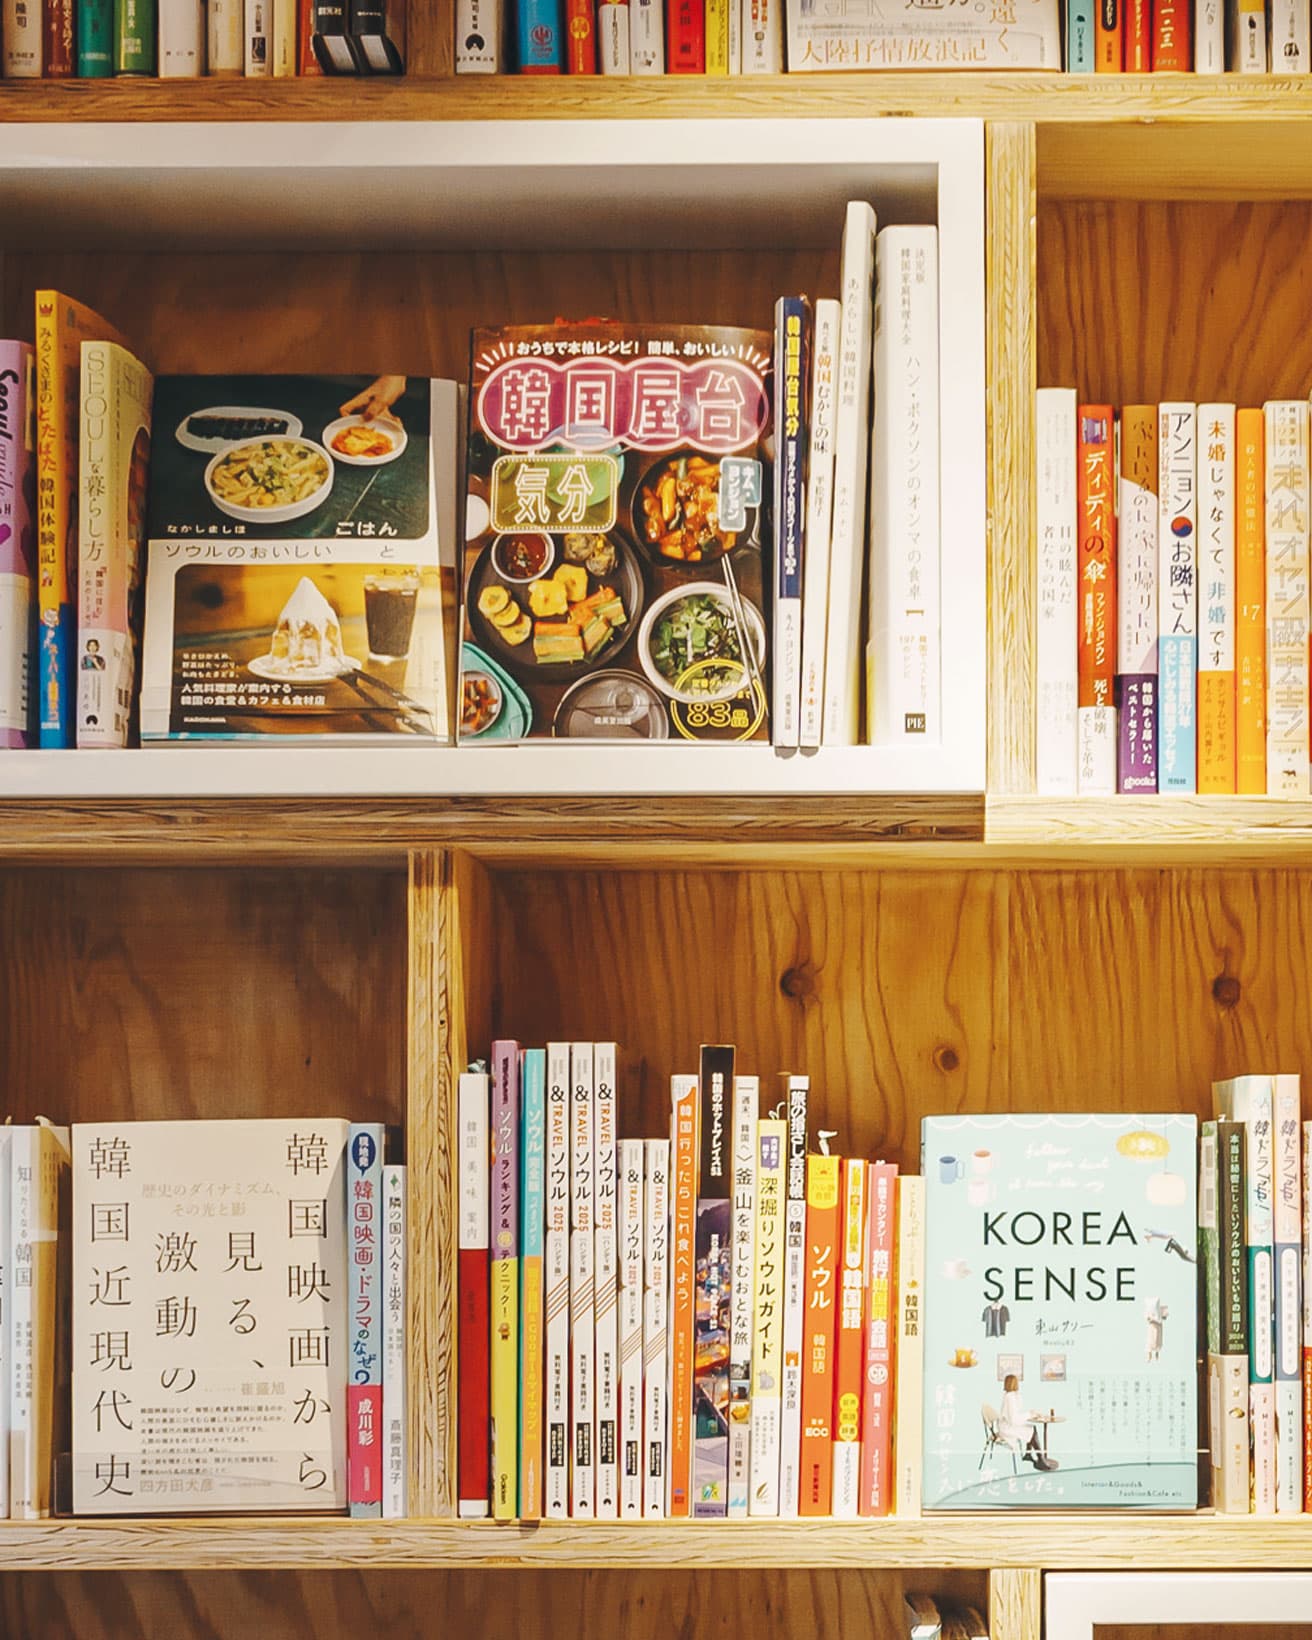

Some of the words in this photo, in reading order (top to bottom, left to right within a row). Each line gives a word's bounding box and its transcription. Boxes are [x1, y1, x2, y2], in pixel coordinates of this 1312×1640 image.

[500, 368, 745, 441] 韓国屋台
[1170, 412, 1193, 515] アンニョン
[514, 464, 595, 523] 気分
[1084, 450, 1106, 585] ディディの傘
[166, 544, 332, 560] ソウルのおいしい
[380, 544, 396, 559] と
[335, 520, 398, 537] ごはん
[1207, 420, 1227, 667] 未婚じゃなくて、非婚です
[1171, 539, 1193, 635] お隣さん
[499, 1110, 513, 1154] ソウル
[551, 1151, 567, 1201] ソウル
[575, 1151, 591, 1201] ソウル
[599, 1149, 615, 1199] ソウル
[553, 1205, 564, 1233] 2025
[578, 1205, 589, 1233] 2025
[602, 1203, 613, 1231] 2025
[627, 1223, 640, 1259] ソウル
[789, 1221, 802, 1248] 韓国
[983, 1210, 1138, 1246] KOREA
[652, 1224, 665, 1261] ソウル
[734, 1168, 753, 1345] 釜山を楽しむおとな旅
[759, 1177, 778, 1360] 深掘りソウルガイド
[810, 1245, 832, 1309] ソウル
[983, 1266, 1136, 1302] SENSE
[88, 1136, 133, 1498] 韓国近現代史
[154, 1231, 199, 1394] 激動の
[222, 1230, 265, 1369] 見る、
[284, 1132, 332, 1491] 韓国映画から
[905, 1294, 918, 1337] 韓国語
[357, 1398, 373, 1447] 成川彩
